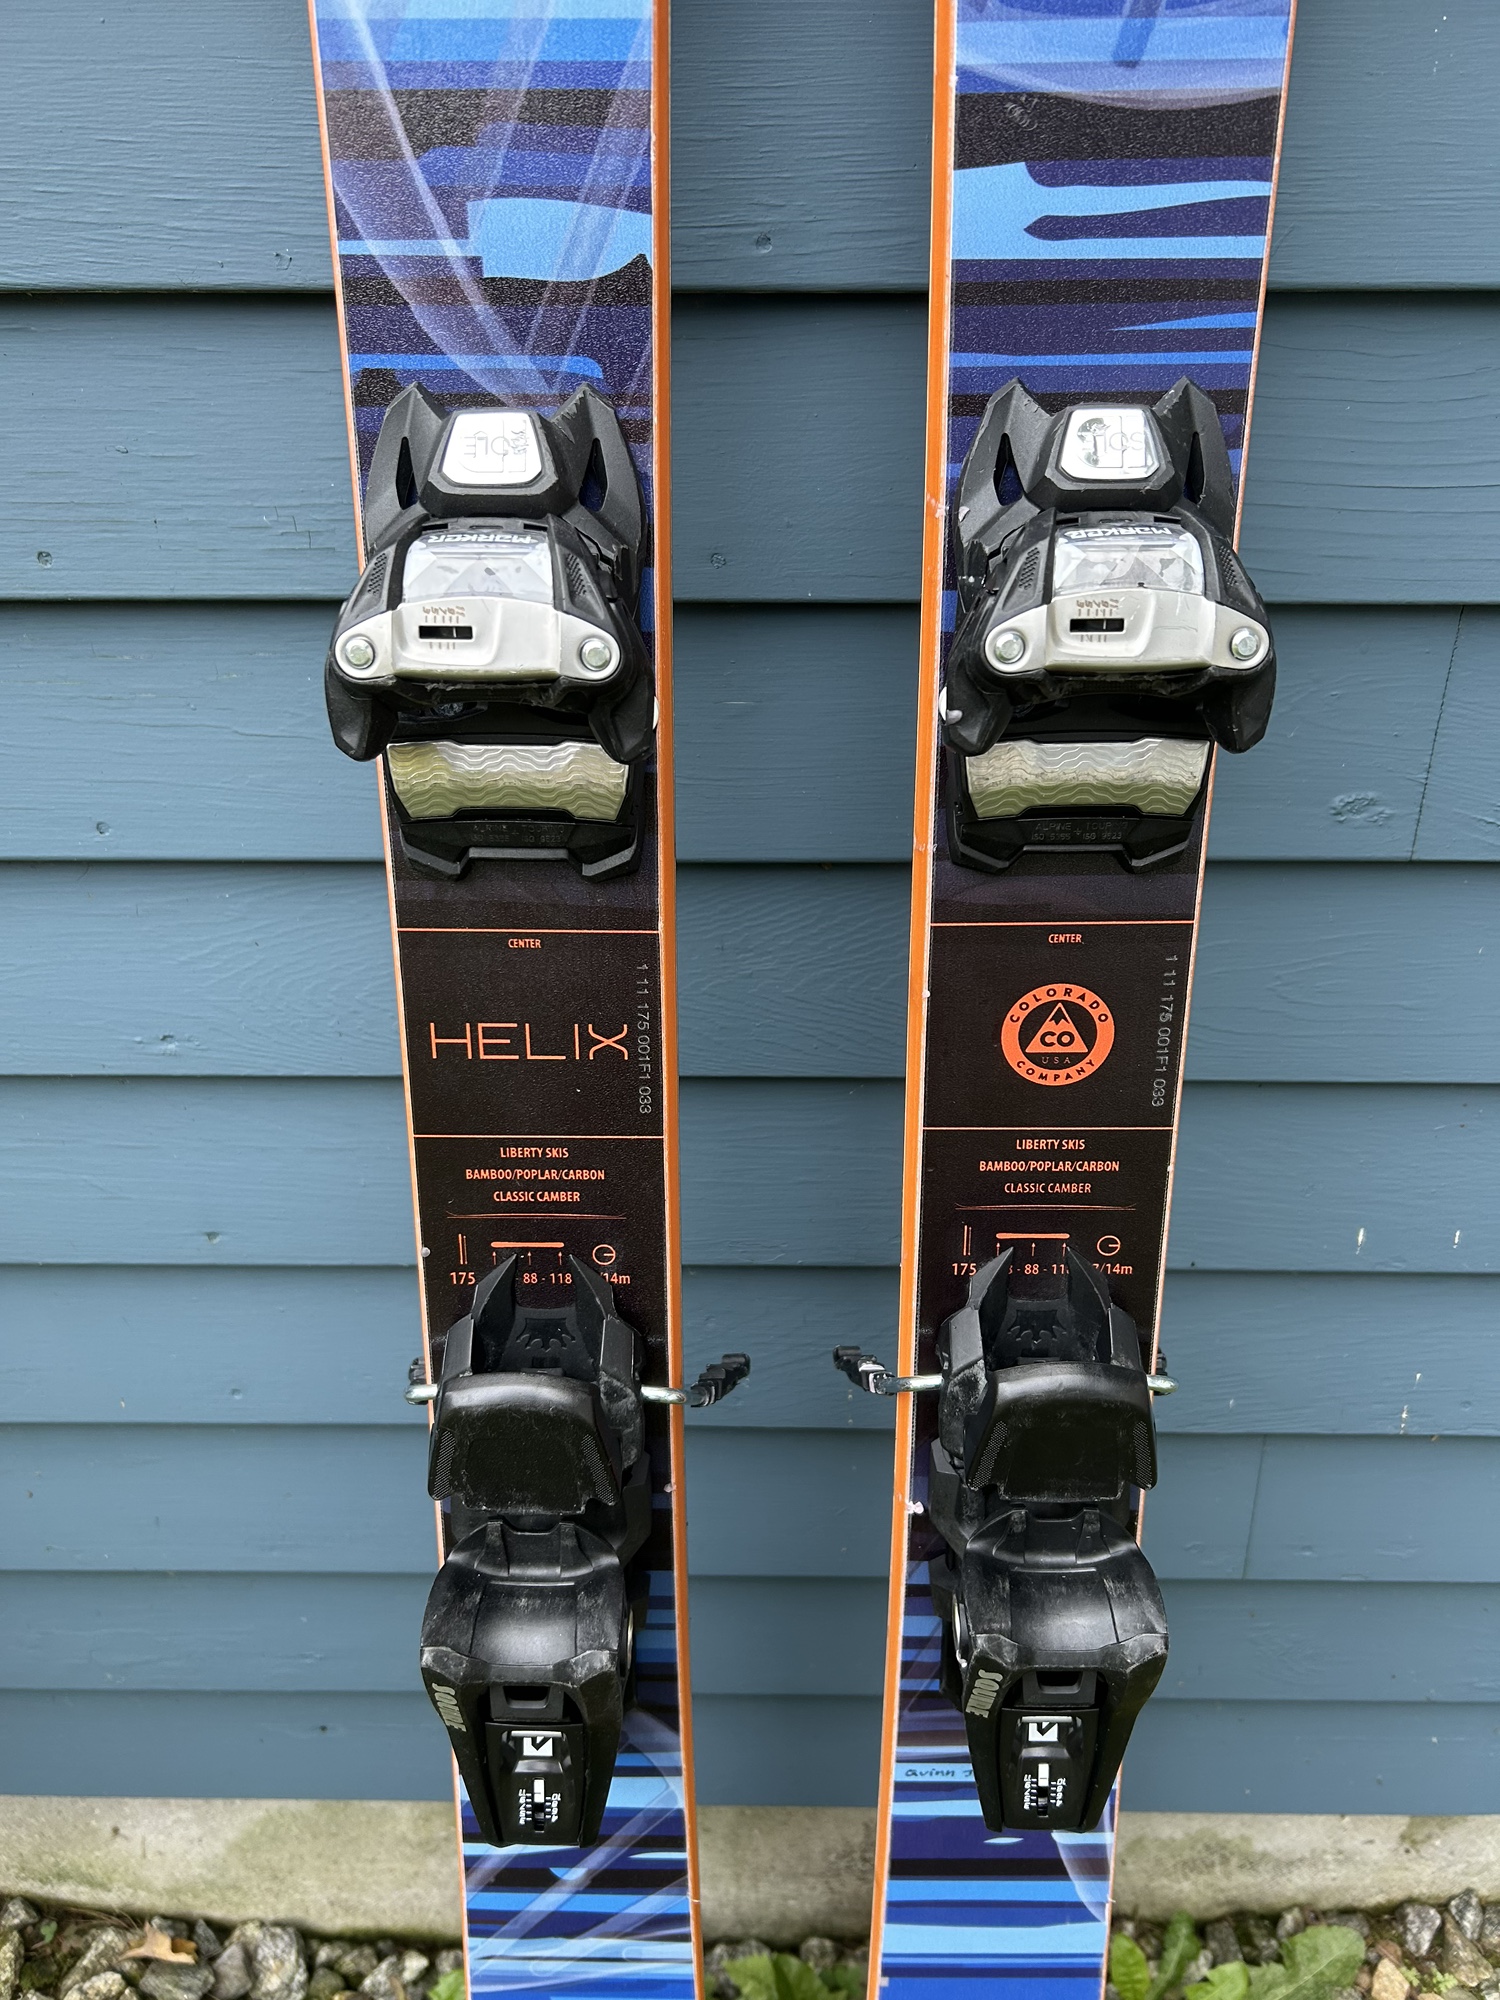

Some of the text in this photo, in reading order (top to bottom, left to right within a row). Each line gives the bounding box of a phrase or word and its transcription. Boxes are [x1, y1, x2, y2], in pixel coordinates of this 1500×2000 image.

[427, 534, 531, 544] MARKER
[1064, 527, 1172, 539] MARKER
[508, 938, 542, 949] CENTER
[1048, 933, 1082, 944] CENTER
[1009, 987, 1109, 1024] COLORADO
[430, 1022, 629, 1060] HELIX
[1040, 1030, 1075, 1047] CO
[1042, 1056, 1071, 1065] USA
[1016, 1059, 1095, 1082] COMPANY
[1151, 1078, 1166, 1107] 033
[1016, 1139, 1085, 1150] LIBERTY SKIS
[500, 1147, 569, 1158] LIBERTY SKIS
[979, 1160, 1120, 1172] BAMBOO/POPLAR/CARBON
[466, 1168, 605, 1180] BAMBOO/POPLAR/CARBON
[1004, 1182, 1092, 1193] CLASSIC CAMBER
[493, 1191, 581, 1202] CLASSIC CAMBER
[952, 1263, 977, 1276] 175
[1024, 1263, 1040, 1274] 88
[450, 1271, 476, 1285] 175
[523, 1272, 538, 1284] 88
[549, 1272, 572, 1284] 118
